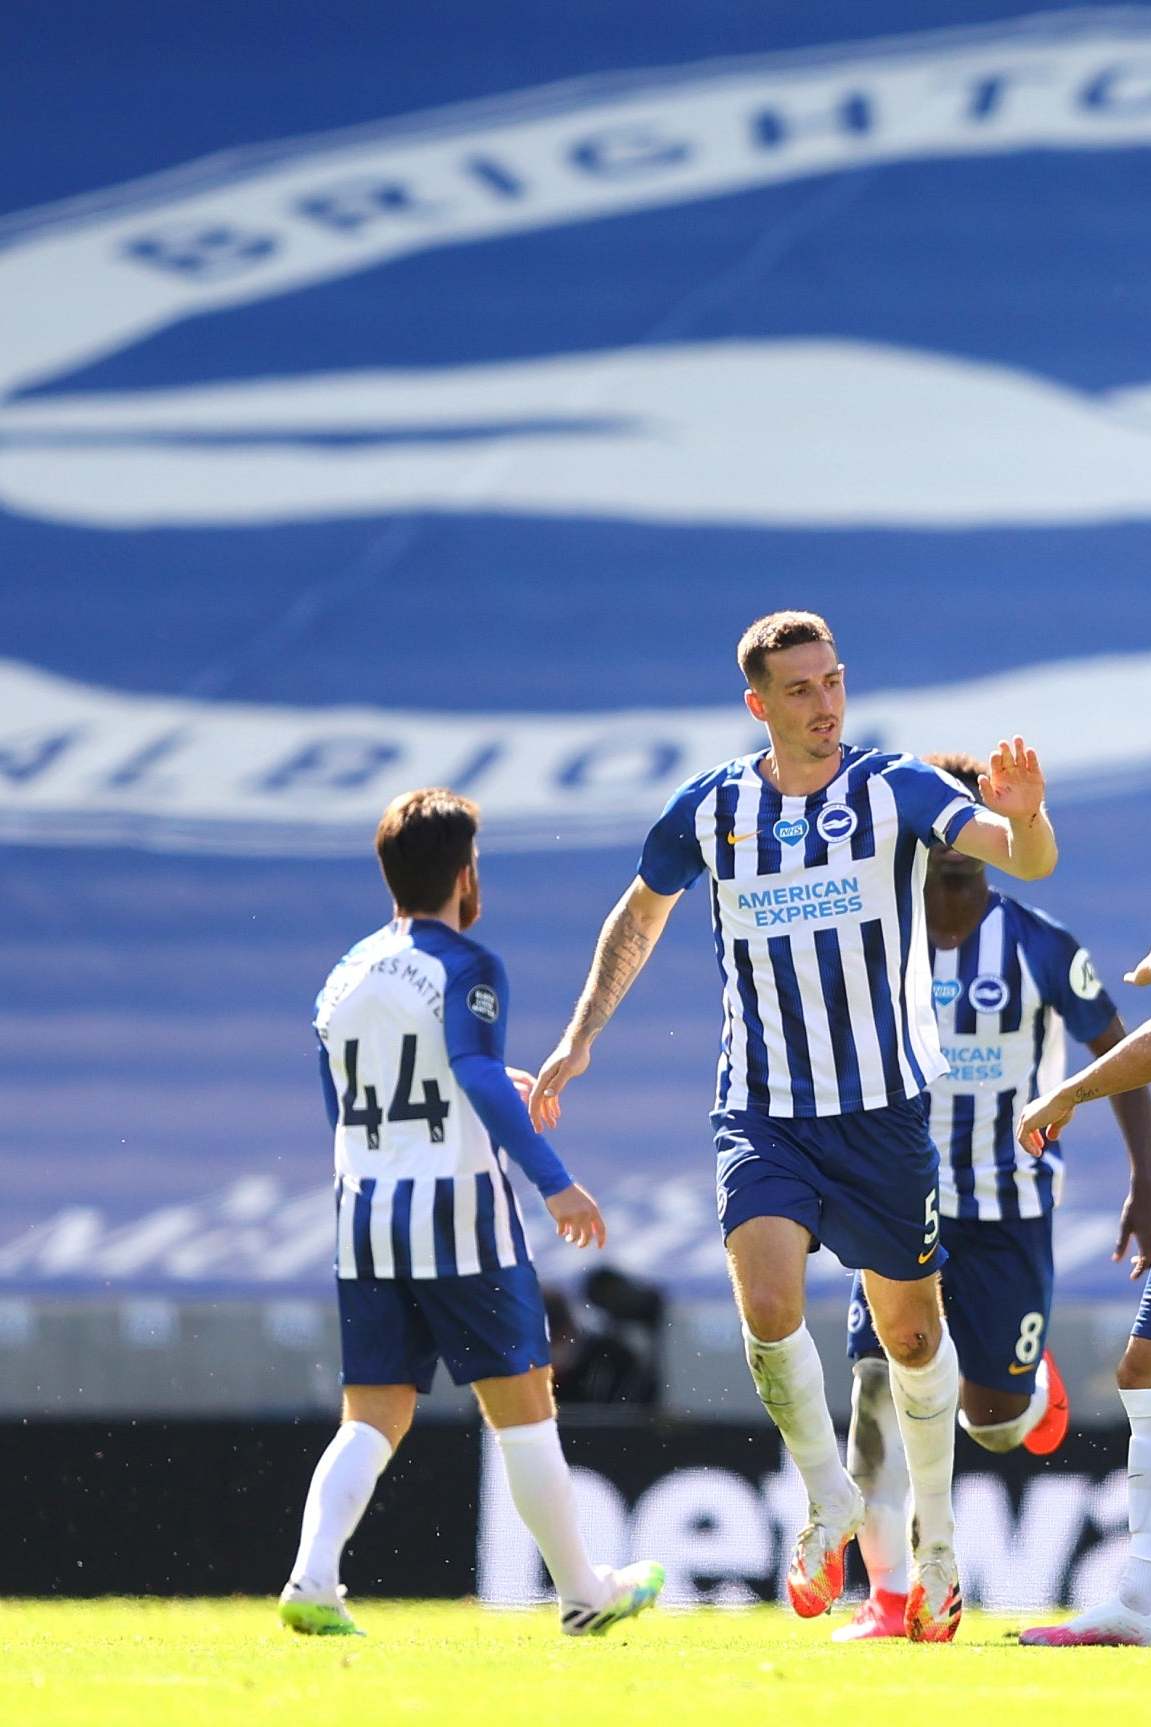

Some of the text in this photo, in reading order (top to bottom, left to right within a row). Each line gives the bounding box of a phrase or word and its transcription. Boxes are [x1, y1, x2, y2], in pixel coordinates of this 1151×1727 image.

[781, 826, 803, 836] NHS
[738, 877, 859, 909] AMERICAN
[754, 896, 863, 927] EXPRESS
[942, 1046, 1002, 1063] RICAN
[949, 1064, 1003, 1081] RESS
[342, 1034, 450, 1150] 44
[923, 1189, 939, 1246] 5
[1015, 1311, 1045, 1365] 8
